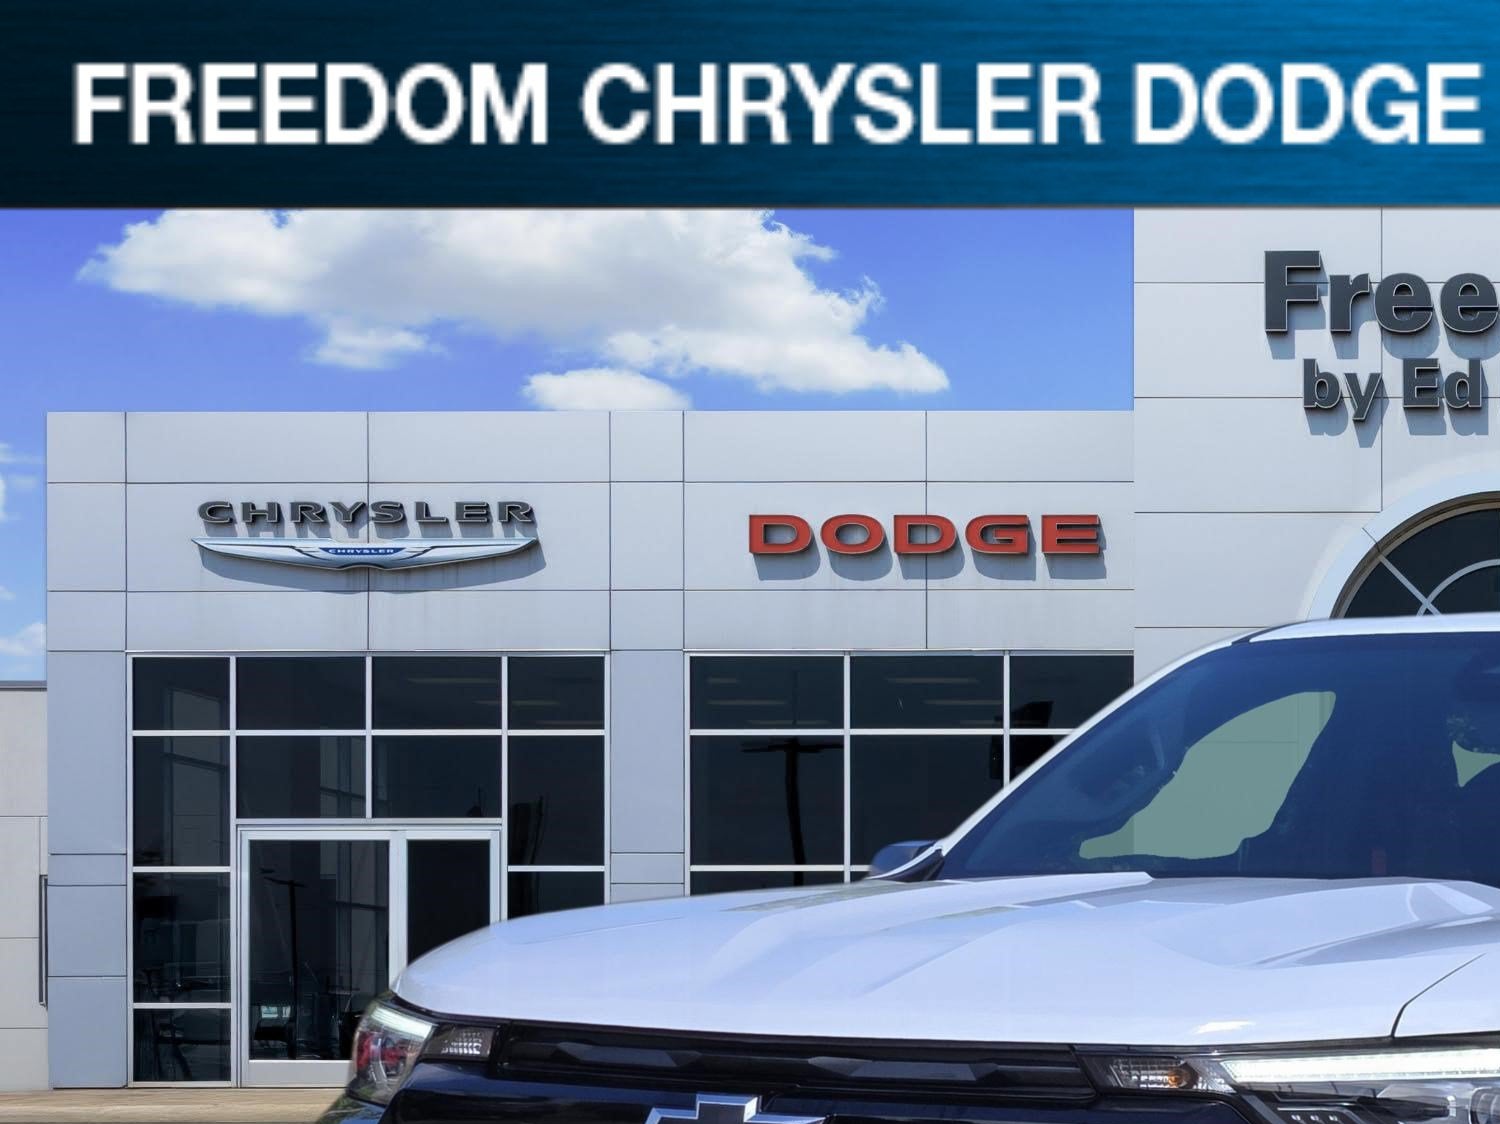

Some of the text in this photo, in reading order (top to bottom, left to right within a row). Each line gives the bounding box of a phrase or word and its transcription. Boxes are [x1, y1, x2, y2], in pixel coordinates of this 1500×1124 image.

[1303, 357, 1383, 421] by
[1402, 357, 1483, 409] Ed
[198, 500, 535, 524] CHRYSLER
[749, 513, 1101, 555] DODGE
